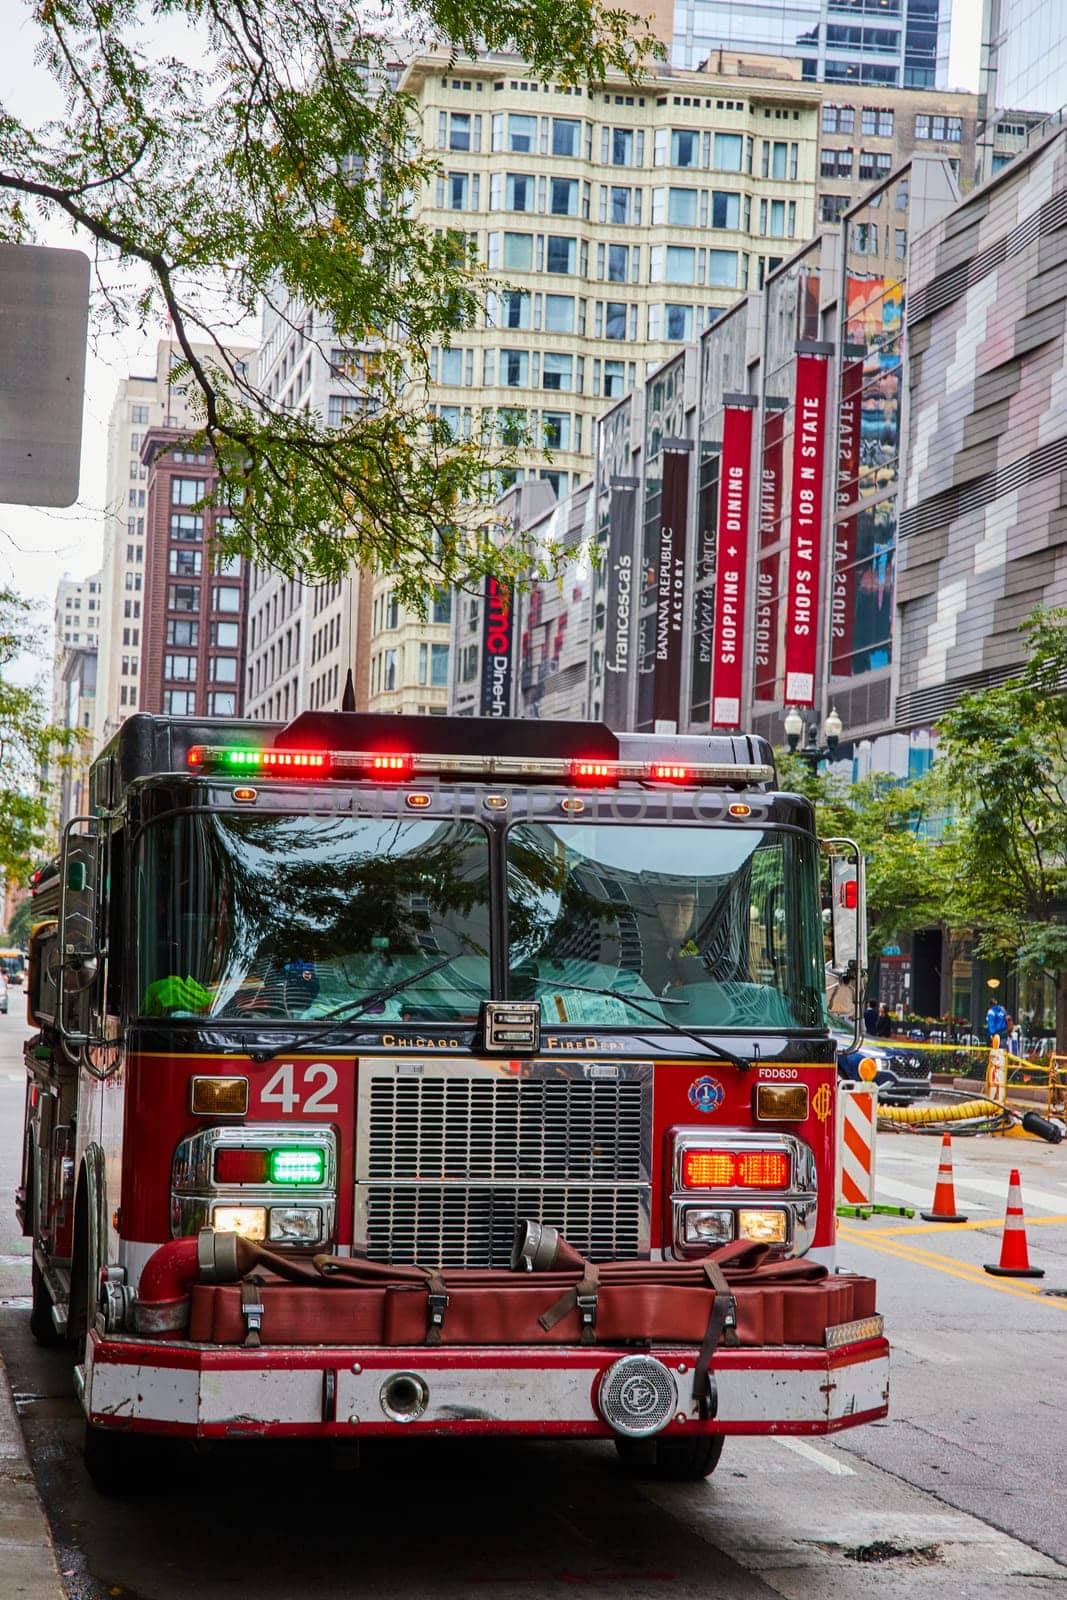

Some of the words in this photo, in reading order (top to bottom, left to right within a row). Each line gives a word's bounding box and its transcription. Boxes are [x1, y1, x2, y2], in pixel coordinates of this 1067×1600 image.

[802, 396, 818, 458] STATE
[727, 467, 743, 531] DINING
[802, 468, 815, 480] N
[800, 489, 814, 525] 108
[660, 527, 673, 598] REPUBLIC
[797, 537, 813, 561] AT
[606, 554, 632, 674] francesca's
[673, 559, 684, 631] FACTORY
[722, 571, 739, 664] SHOPPING
[795, 570, 811, 636] SHOPS
[657, 604, 669, 661] BANANA
[492, 656, 508, 717] Dine-In
[260, 1063, 339, 1114] 42
[759, 1069, 798, 1079] FDD630
